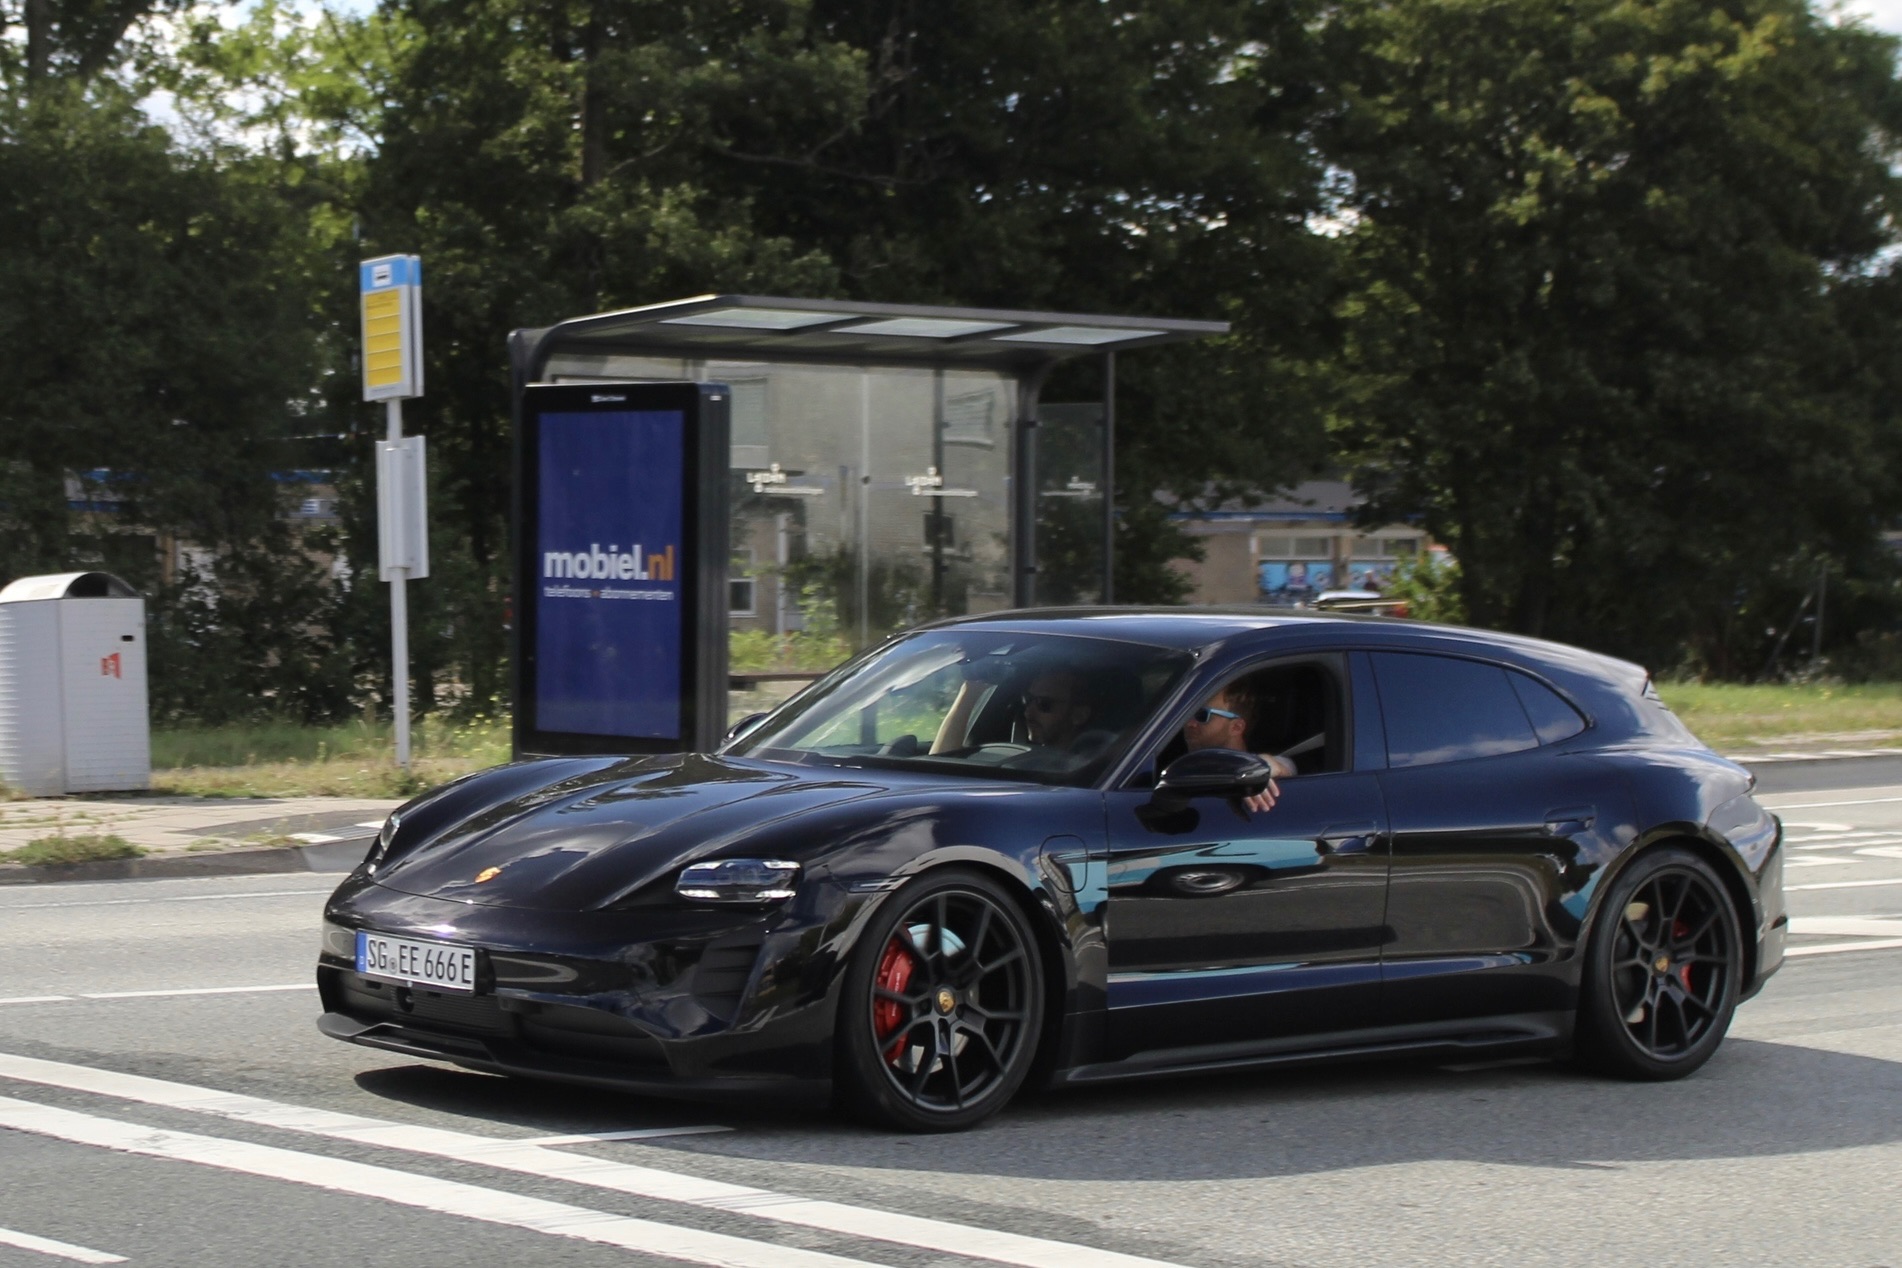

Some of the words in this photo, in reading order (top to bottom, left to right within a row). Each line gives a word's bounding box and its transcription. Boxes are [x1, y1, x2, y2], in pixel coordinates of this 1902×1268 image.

[544, 543, 674, 581] mobiel.nl
[367, 939, 388, 970] SG
[399, 944, 420, 976] EE
